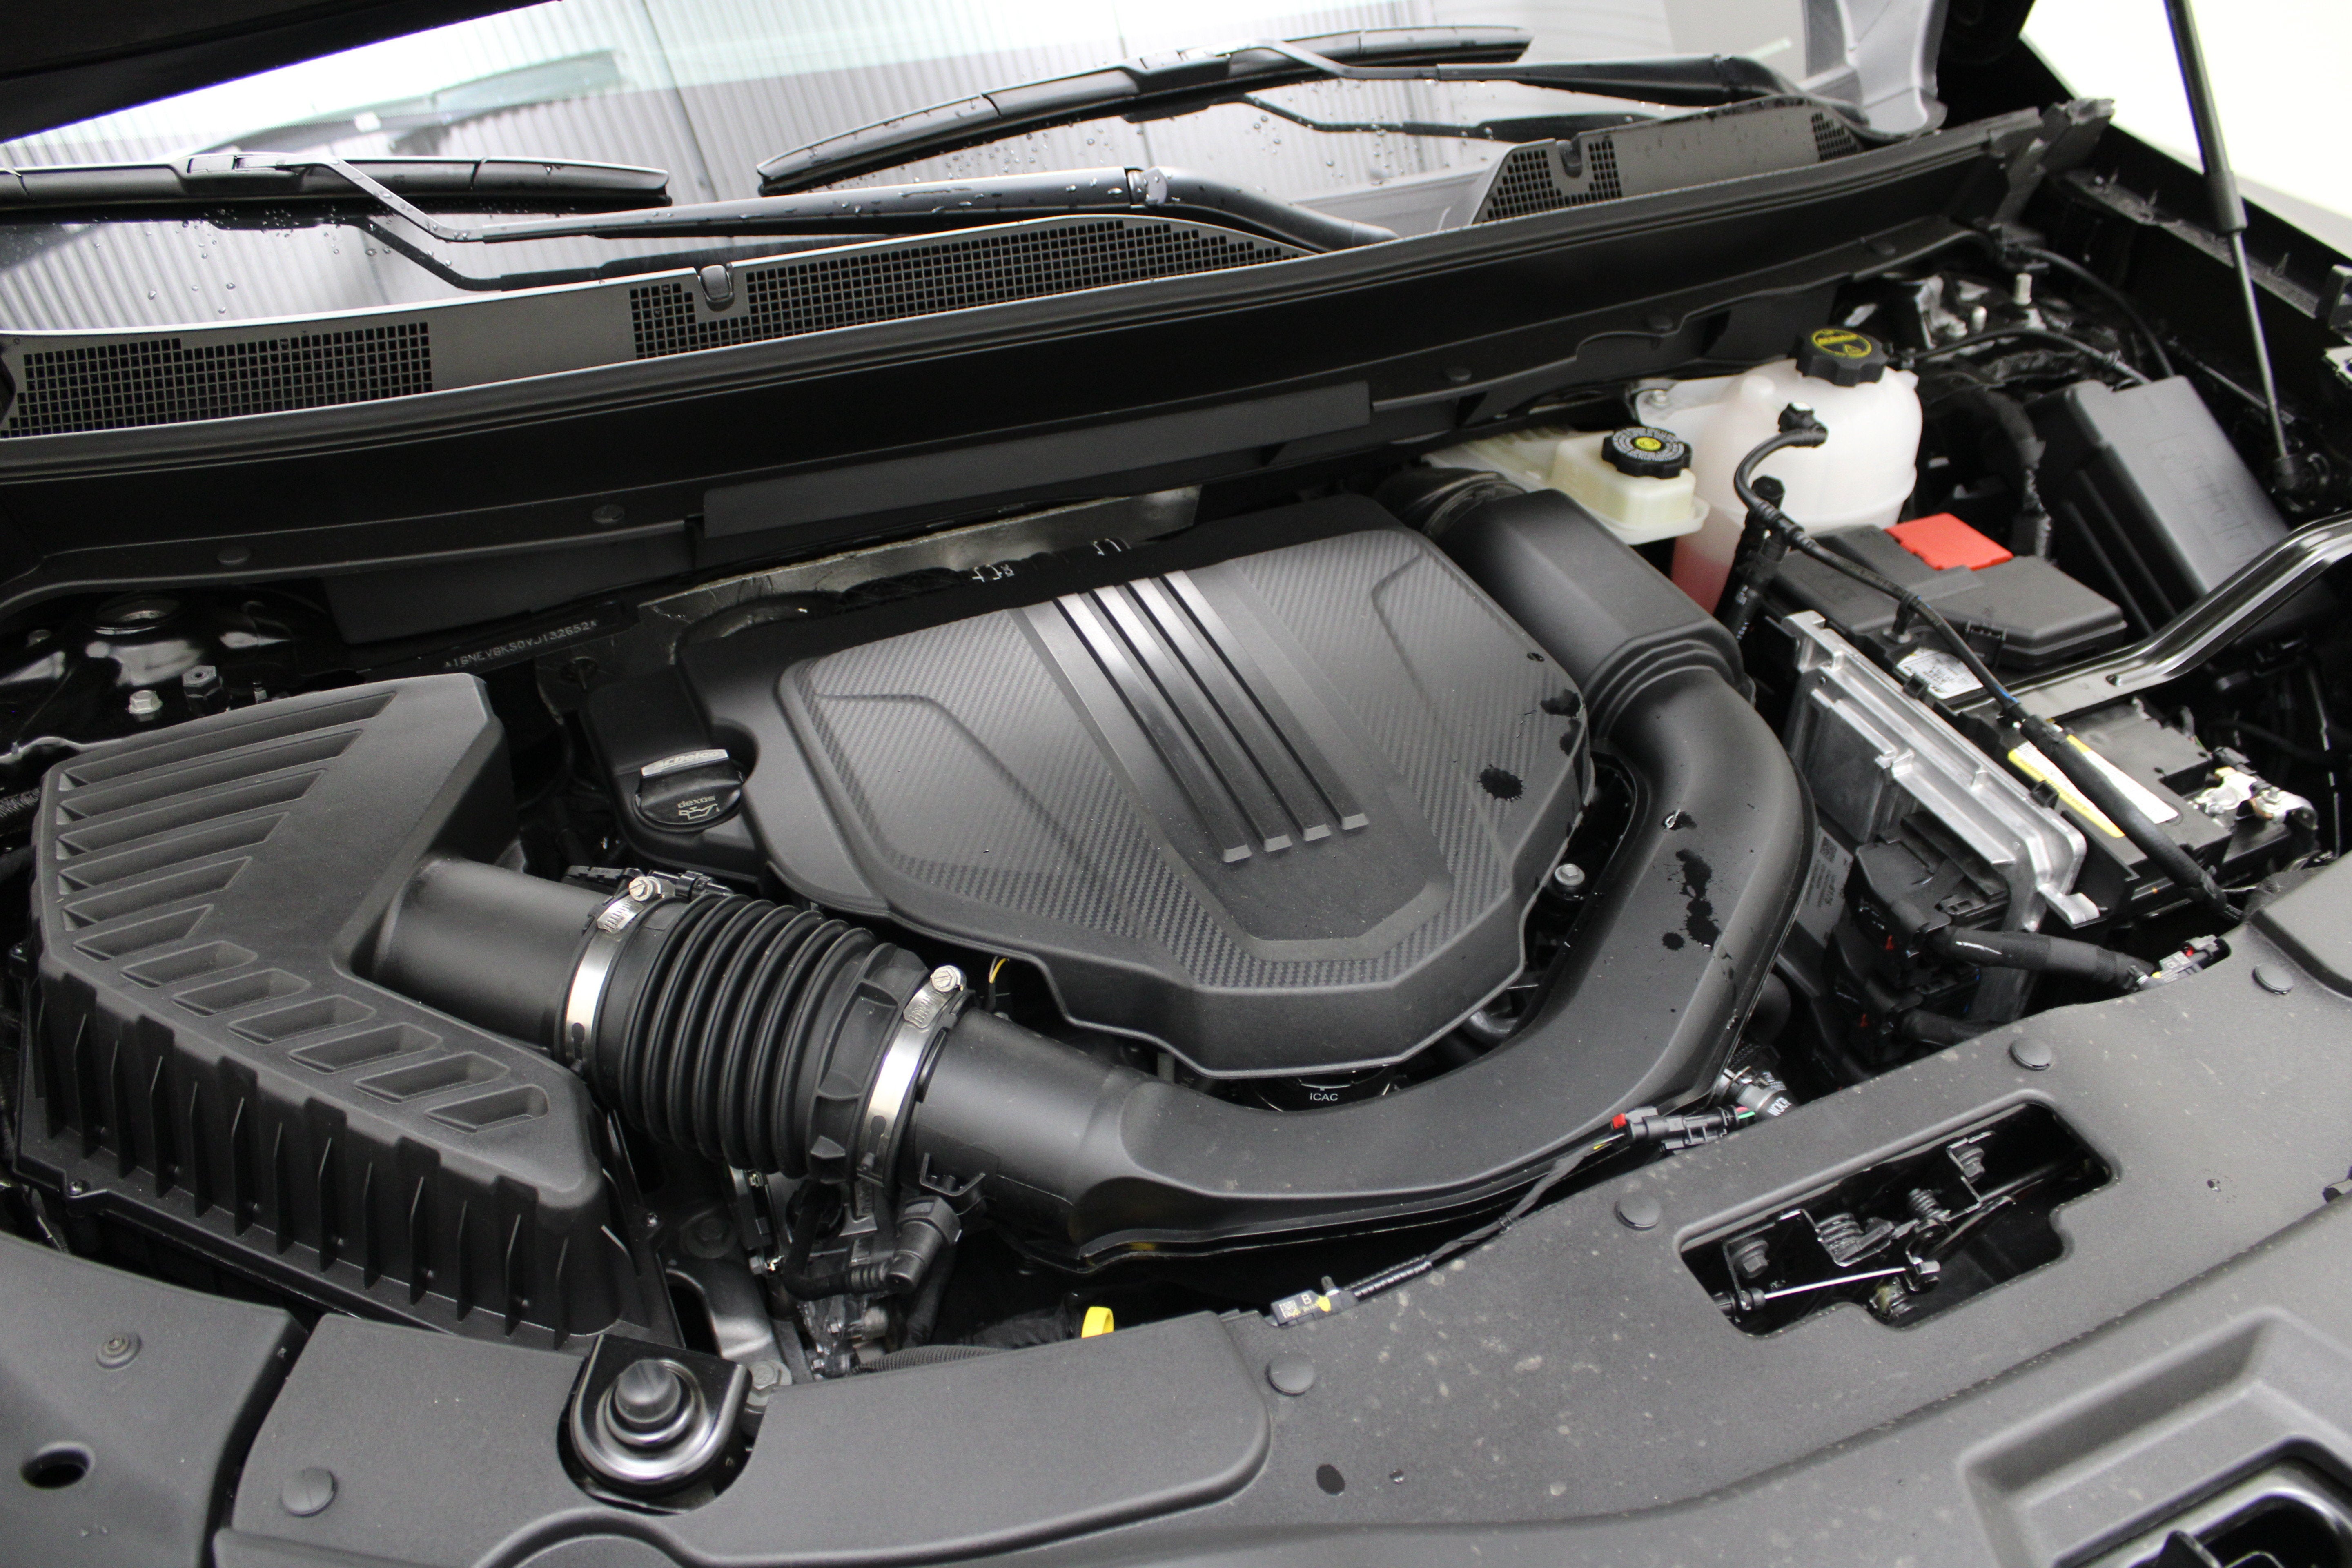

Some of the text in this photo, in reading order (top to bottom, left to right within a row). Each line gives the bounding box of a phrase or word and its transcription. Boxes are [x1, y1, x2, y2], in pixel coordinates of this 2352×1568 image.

[677, 795, 716, 808] dexos
[1310, 1092, 1339, 1101] ICAC
[1301, 1294, 1312, 1305] B
